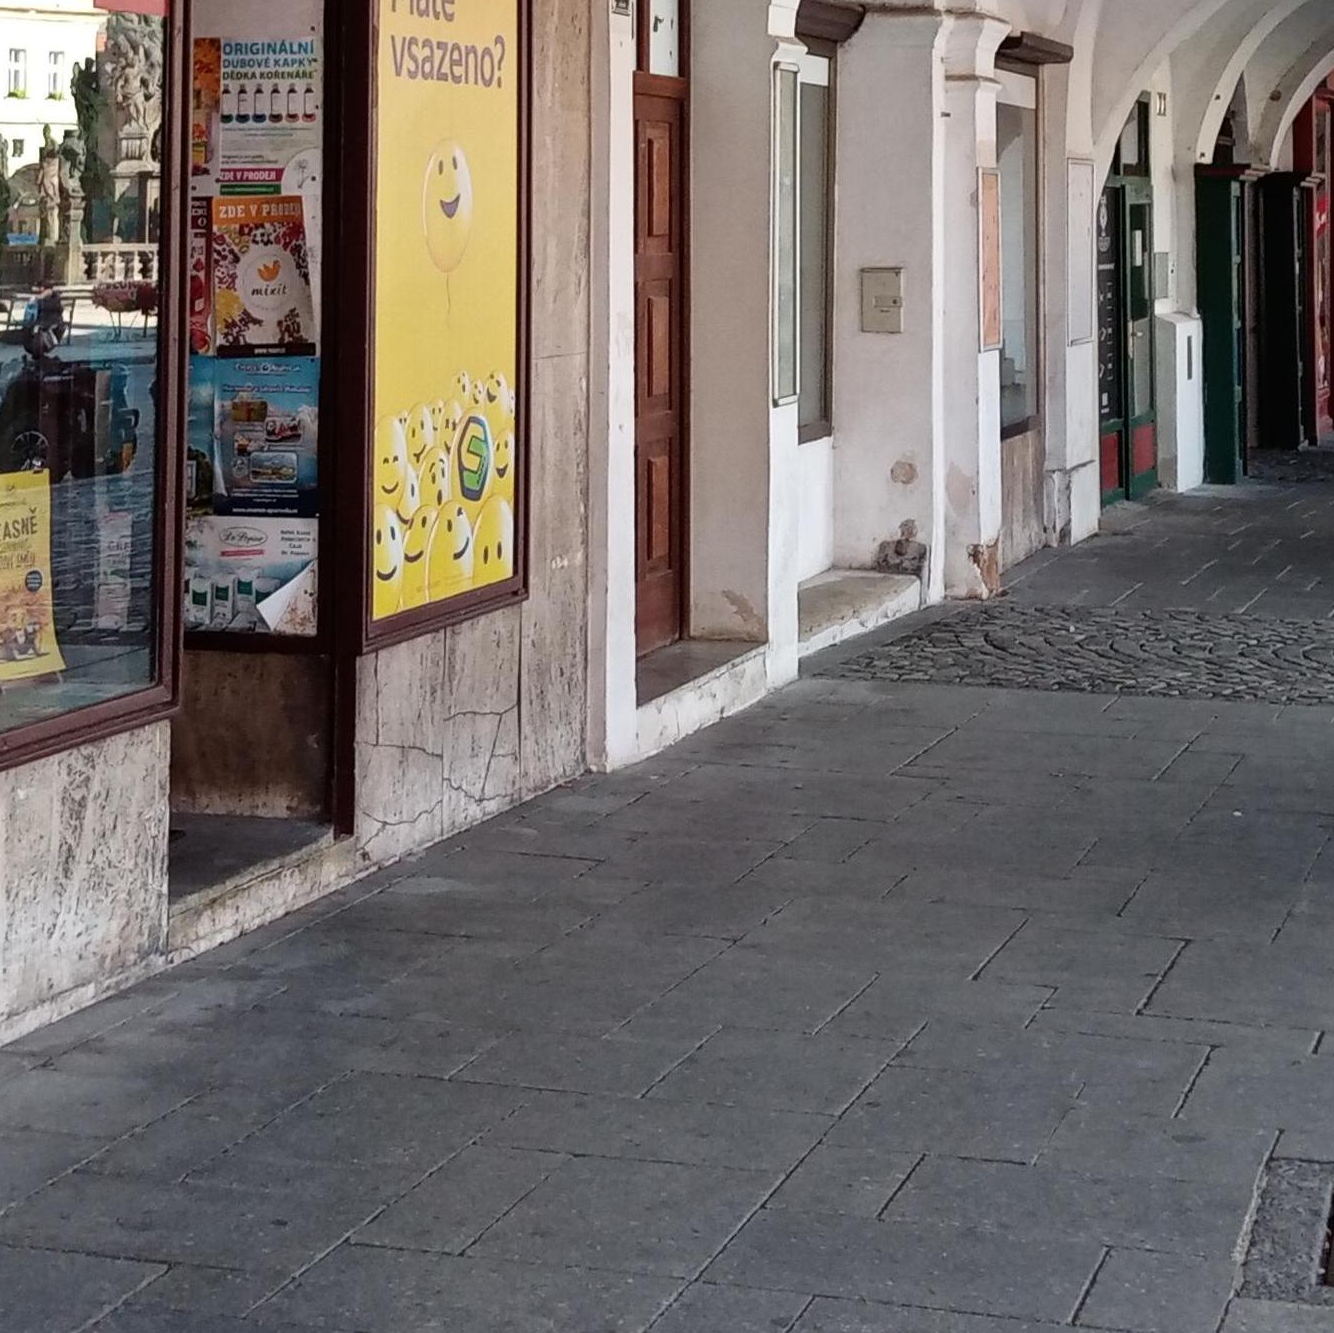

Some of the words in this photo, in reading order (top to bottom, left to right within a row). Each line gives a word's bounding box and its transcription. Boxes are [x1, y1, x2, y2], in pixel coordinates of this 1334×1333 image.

[223, 39, 314, 56] ORIGINÁLNÍ
[223, 56, 270, 68] DUBOVÉ
[391, 35, 505, 88] vsazeno?
[223, 69, 257, 81] DĚDKA
[220, 171, 233, 181] ZDE
[219, 205, 245, 218] ZDE
[250, 204, 258, 217] V
[251, 283, 287, 296] mixit
